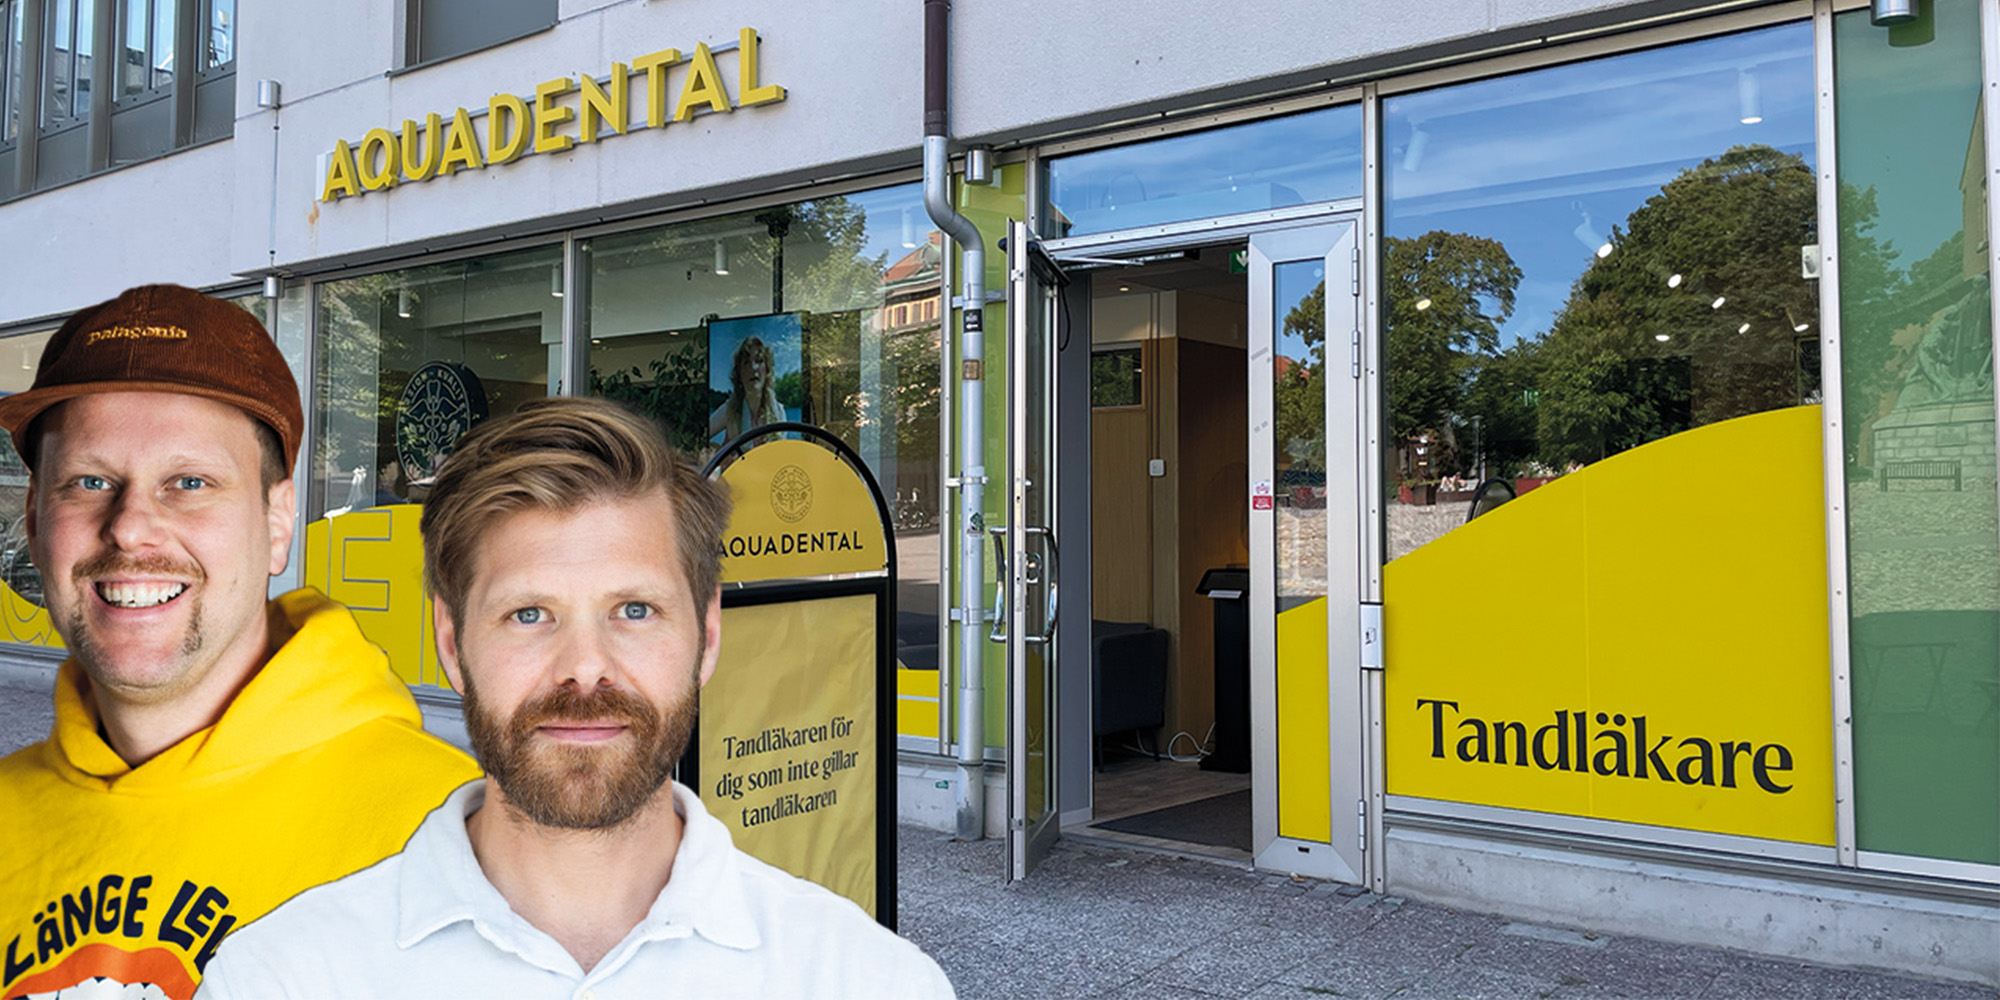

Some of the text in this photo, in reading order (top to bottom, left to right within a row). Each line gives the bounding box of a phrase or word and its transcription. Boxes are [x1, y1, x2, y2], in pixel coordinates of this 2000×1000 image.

[321, 27, 785, 202] AQUADENTAL
[87, 326, 188, 346] patagonia
[723, 716, 854, 760] Tandläkaren för
[1416, 698, 1794, 795] Tandläkare
[716, 750, 859, 800] dig som inte gillar
[742, 789, 837, 828] tandläkaren
[3, 874, 153, 988] LÄNGE
